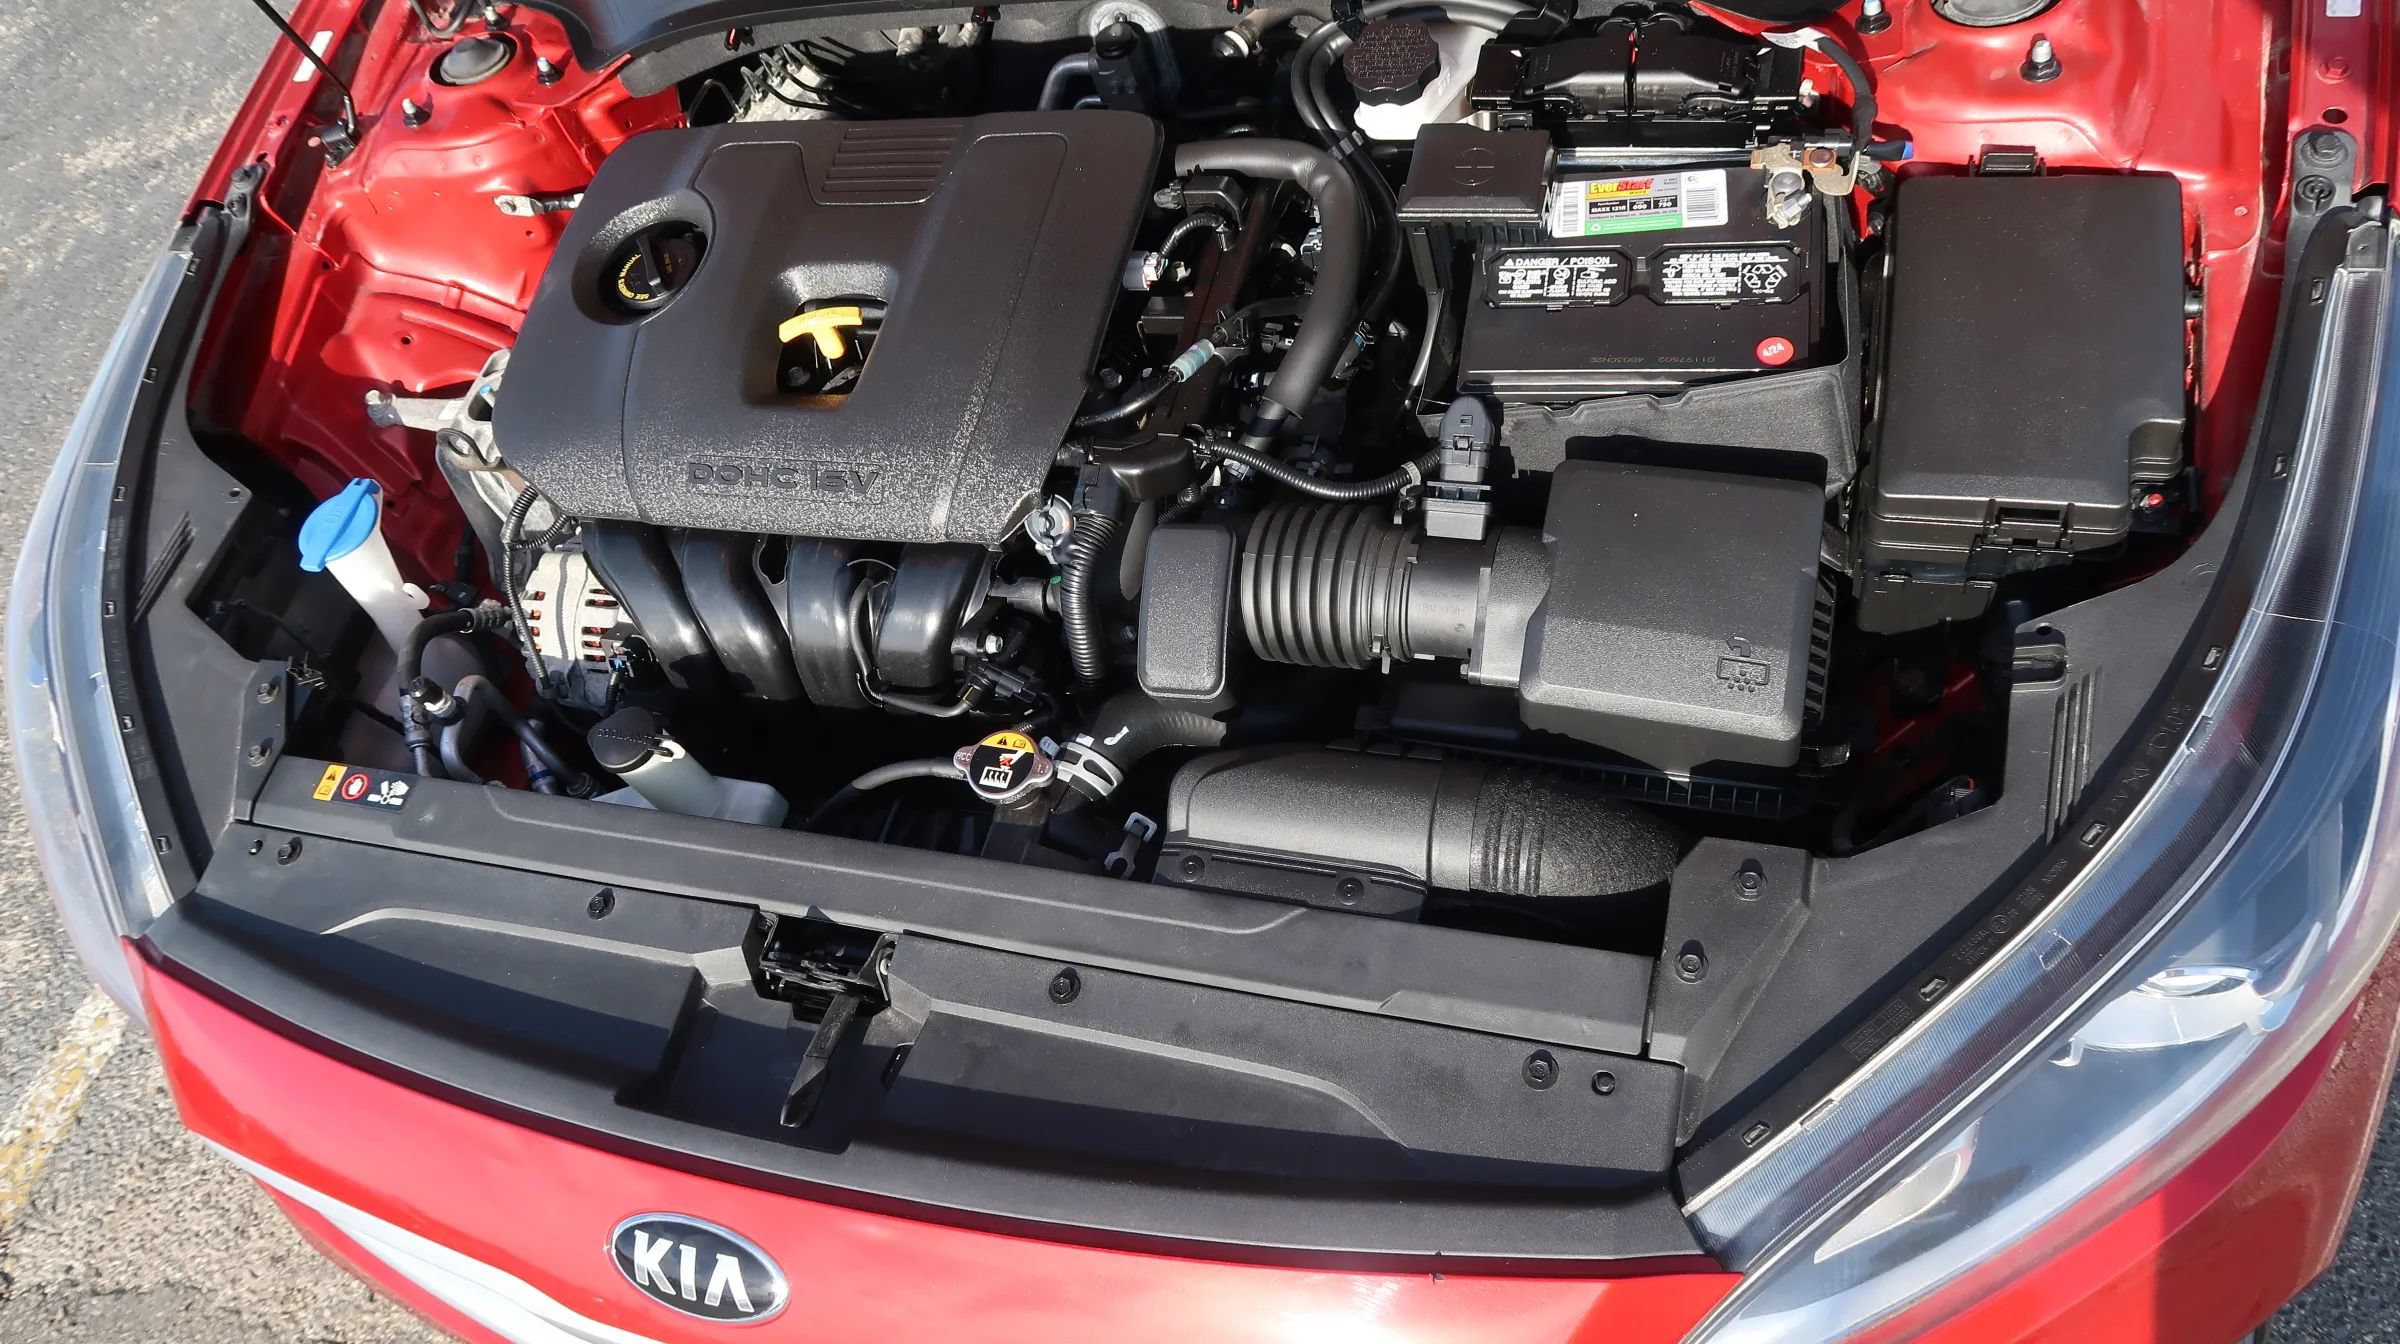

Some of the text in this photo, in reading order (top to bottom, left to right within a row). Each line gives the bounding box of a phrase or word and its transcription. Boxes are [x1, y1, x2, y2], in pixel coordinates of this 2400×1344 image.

[1590, 178, 1655, 194] EverStart
[619, 253, 641, 277] MANUAL
[1515, 257, 1560, 266] DANGER
[1570, 256, 1611, 265] POISON
[1762, 342, 1785, 357] 4/24
[687, 462, 800, 489] DOHC
[955, 752, 972, 762] HCC
[633, 1229, 756, 1314] KIA
